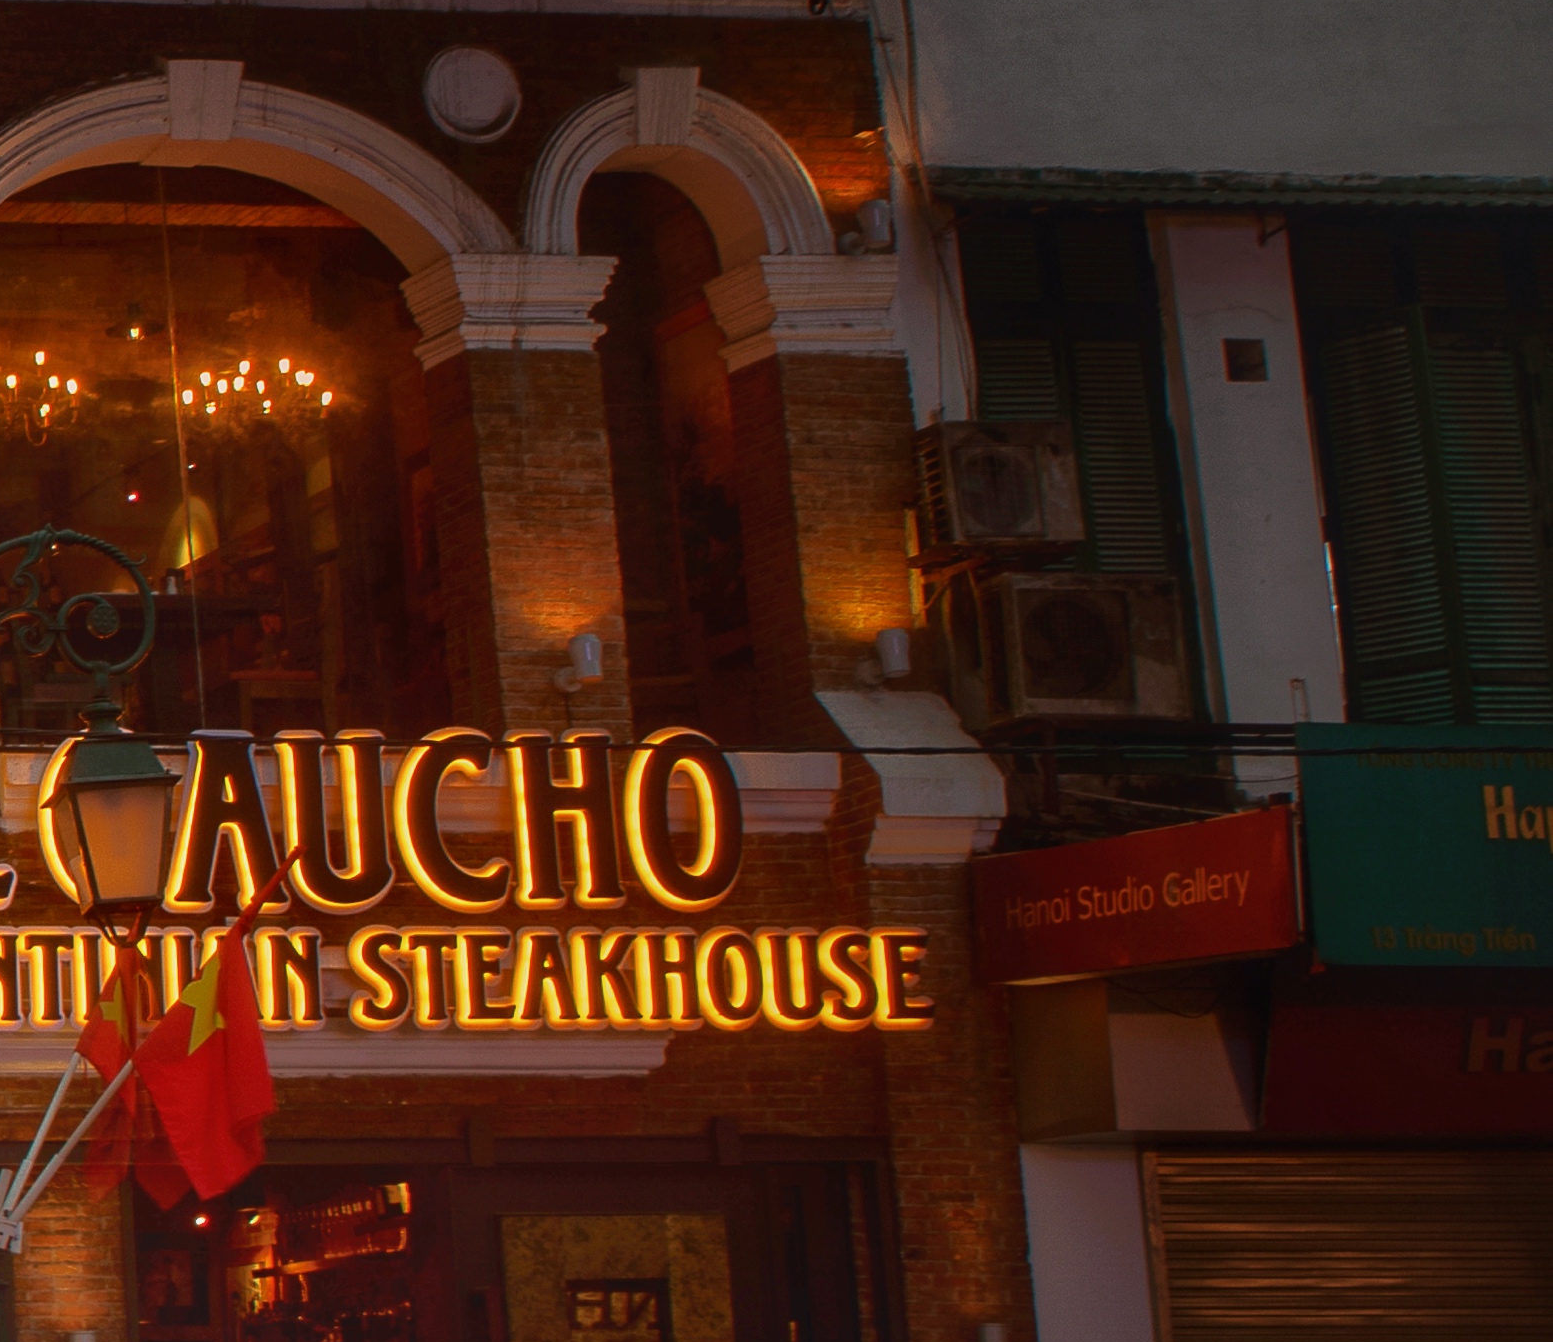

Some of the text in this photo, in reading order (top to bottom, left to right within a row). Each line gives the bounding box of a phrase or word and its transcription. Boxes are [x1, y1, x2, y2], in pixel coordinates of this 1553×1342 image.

[1005, 866, 1250, 930] Hanoi Studio Gallery
[1370, 925, 1398, 950] 13
[348, 925, 938, 1033] STEAKHOUSE
